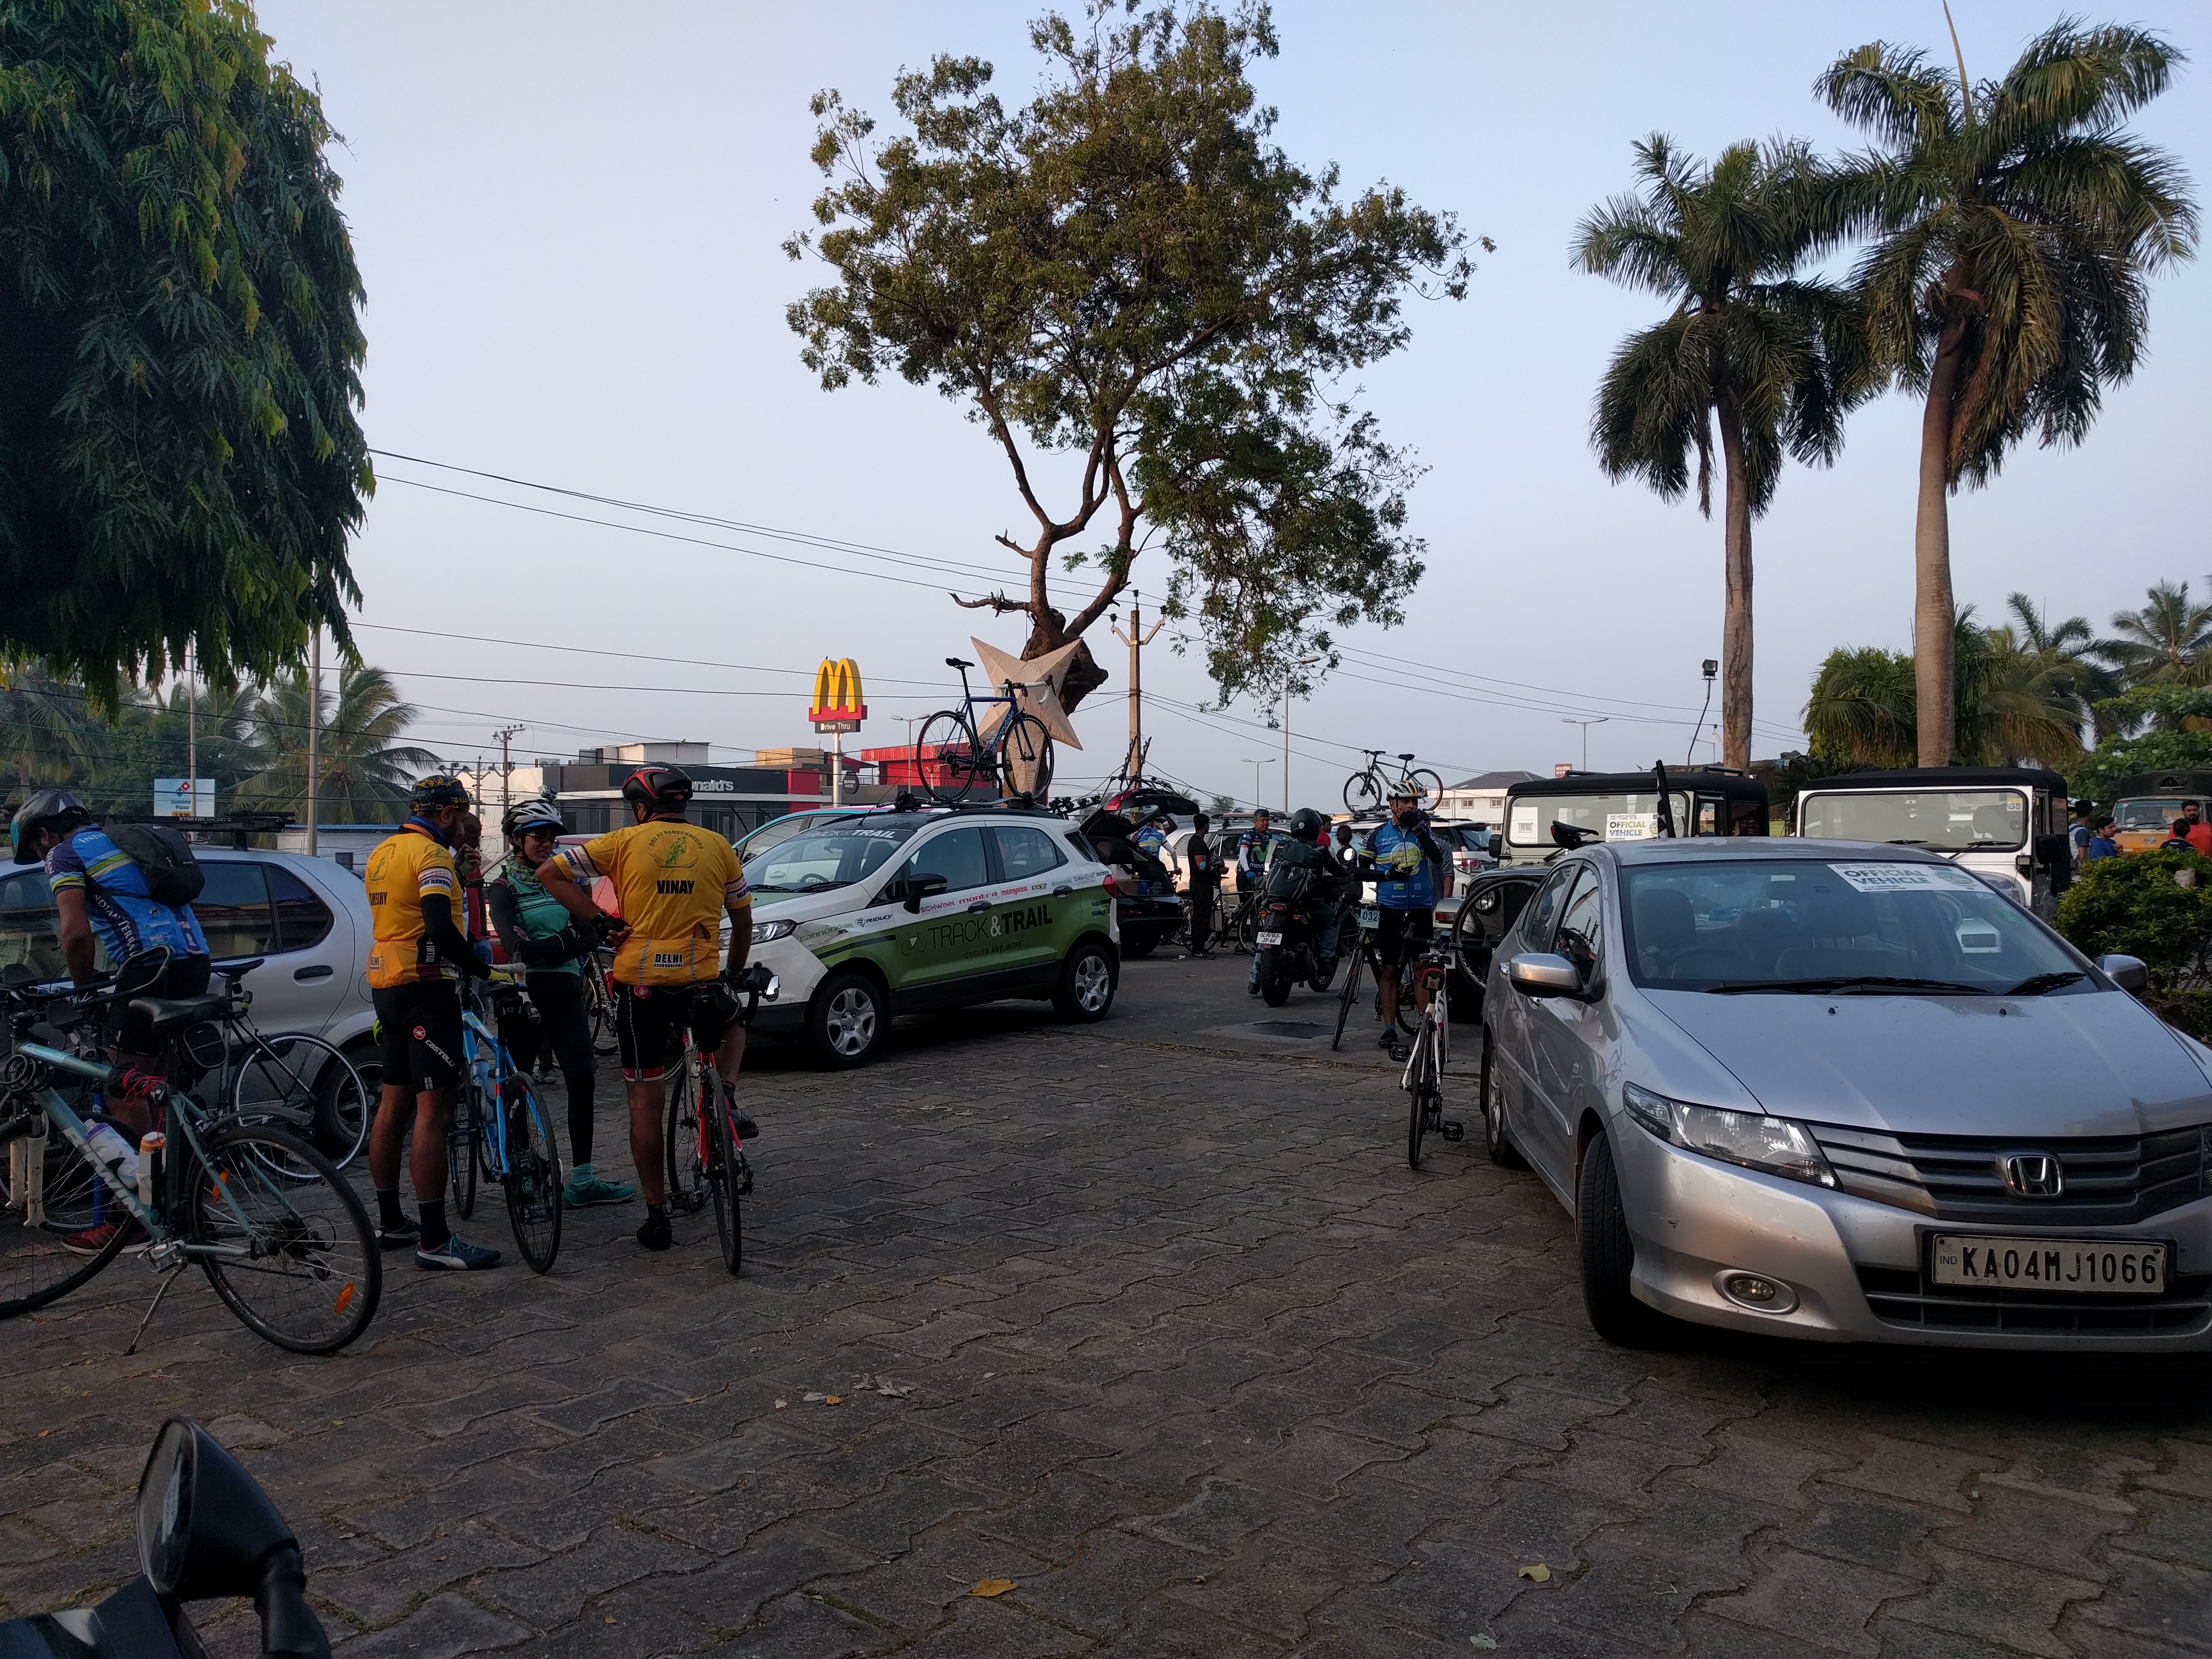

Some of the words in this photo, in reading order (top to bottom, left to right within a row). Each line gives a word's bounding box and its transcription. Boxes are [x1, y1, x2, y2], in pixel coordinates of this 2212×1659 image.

[820, 723, 836, 731] Drive
[990, 710, 1014, 753] annondale
[649, 832, 664, 847] DELHI
[664, 830, 704, 850] RANDONNEURS
[656, 880, 696, 894] VINAY
[1852, 877, 1932, 885] VEHICLE
[800, 922, 854, 943] cannondale
[866, 913, 893, 924] RIDLEY
[920, 900, 955, 913] SCHWINN
[958, 891, 997, 904] montra
[1001, 885, 1029, 896] mongoose
[1051, 878, 1072, 887] Bianchi
[1073, 872, 1095, 882] DAHON
[1363, 911, 1378, 922] 032
[426, 945, 435, 962] DELHI
[964, 949, 989, 959] CYCLES
[991, 945, 1004, 953] AND
[1006, 940, 1023, 950] MORE
[654, 953, 683, 963] DELHI
[1939, 1255, 1957, 1265] IND
[1962, 1246, 2157, 1284] KA04MJ1066
